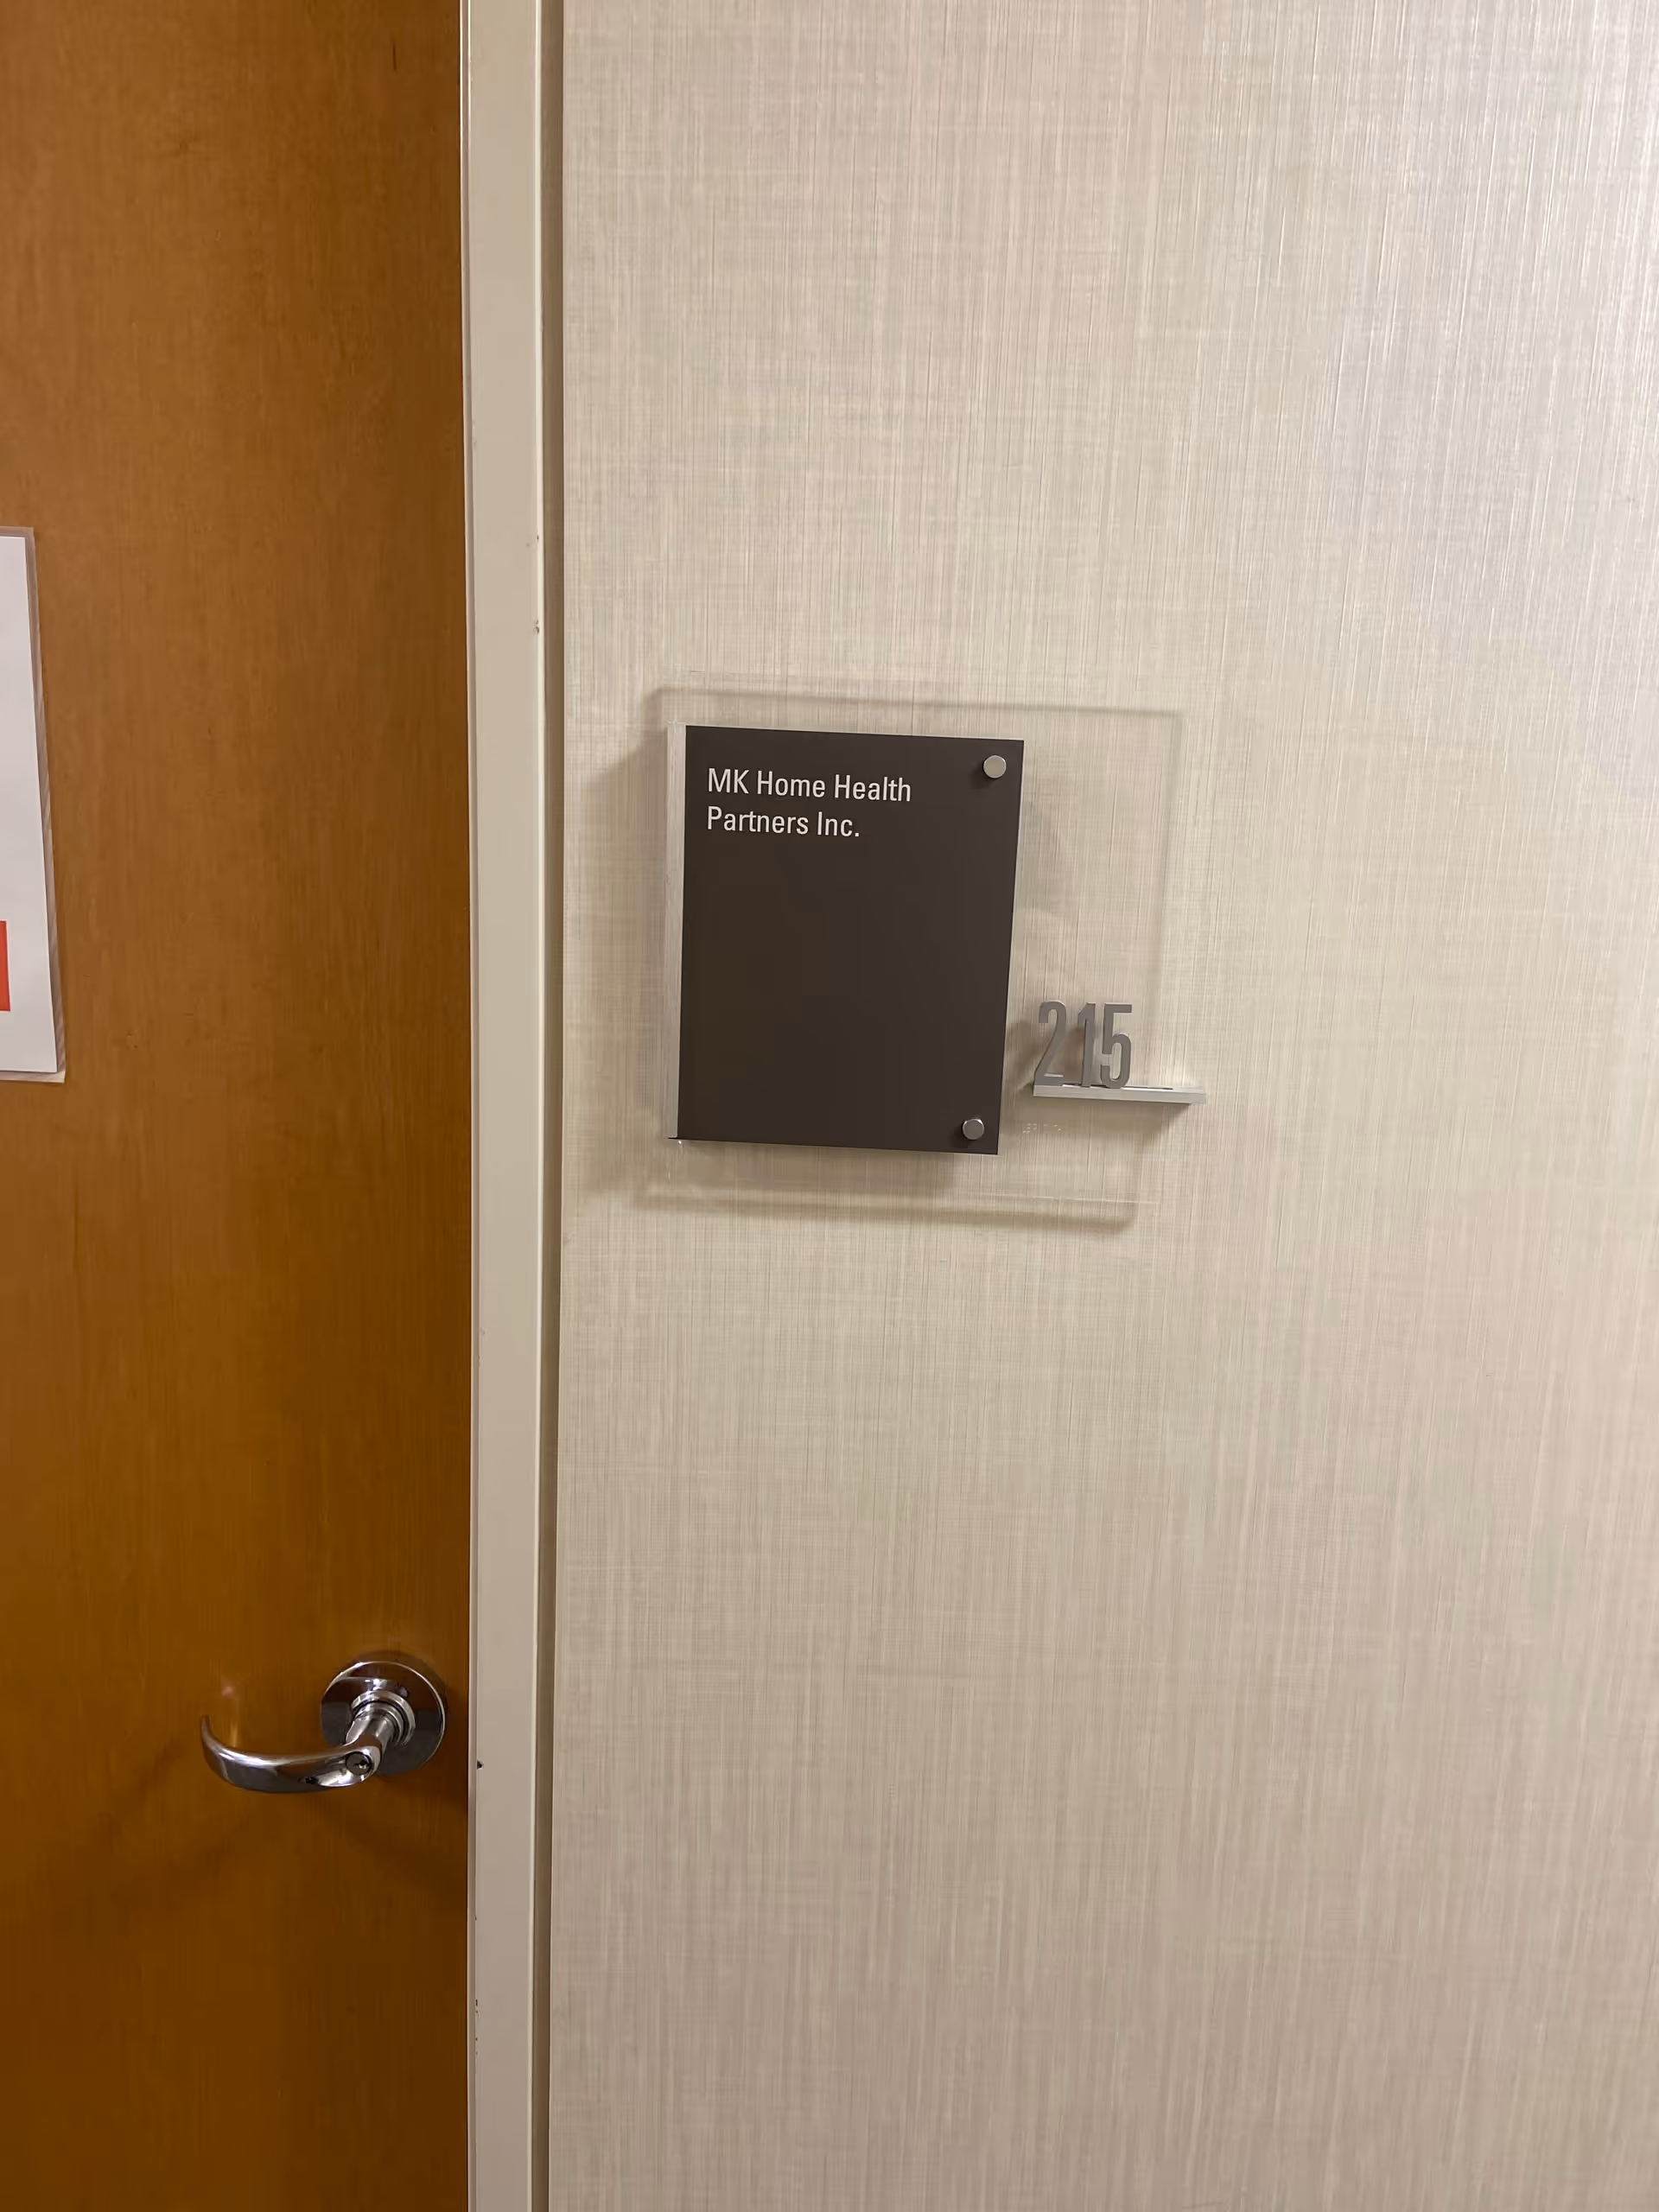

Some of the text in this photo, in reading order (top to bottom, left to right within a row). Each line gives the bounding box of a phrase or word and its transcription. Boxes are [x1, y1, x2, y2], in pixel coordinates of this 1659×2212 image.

[709, 768, 910, 801] MK Home Health
[709, 806, 859, 836] Partners Inc.
[1033, 1000, 1133, 1089] 215
